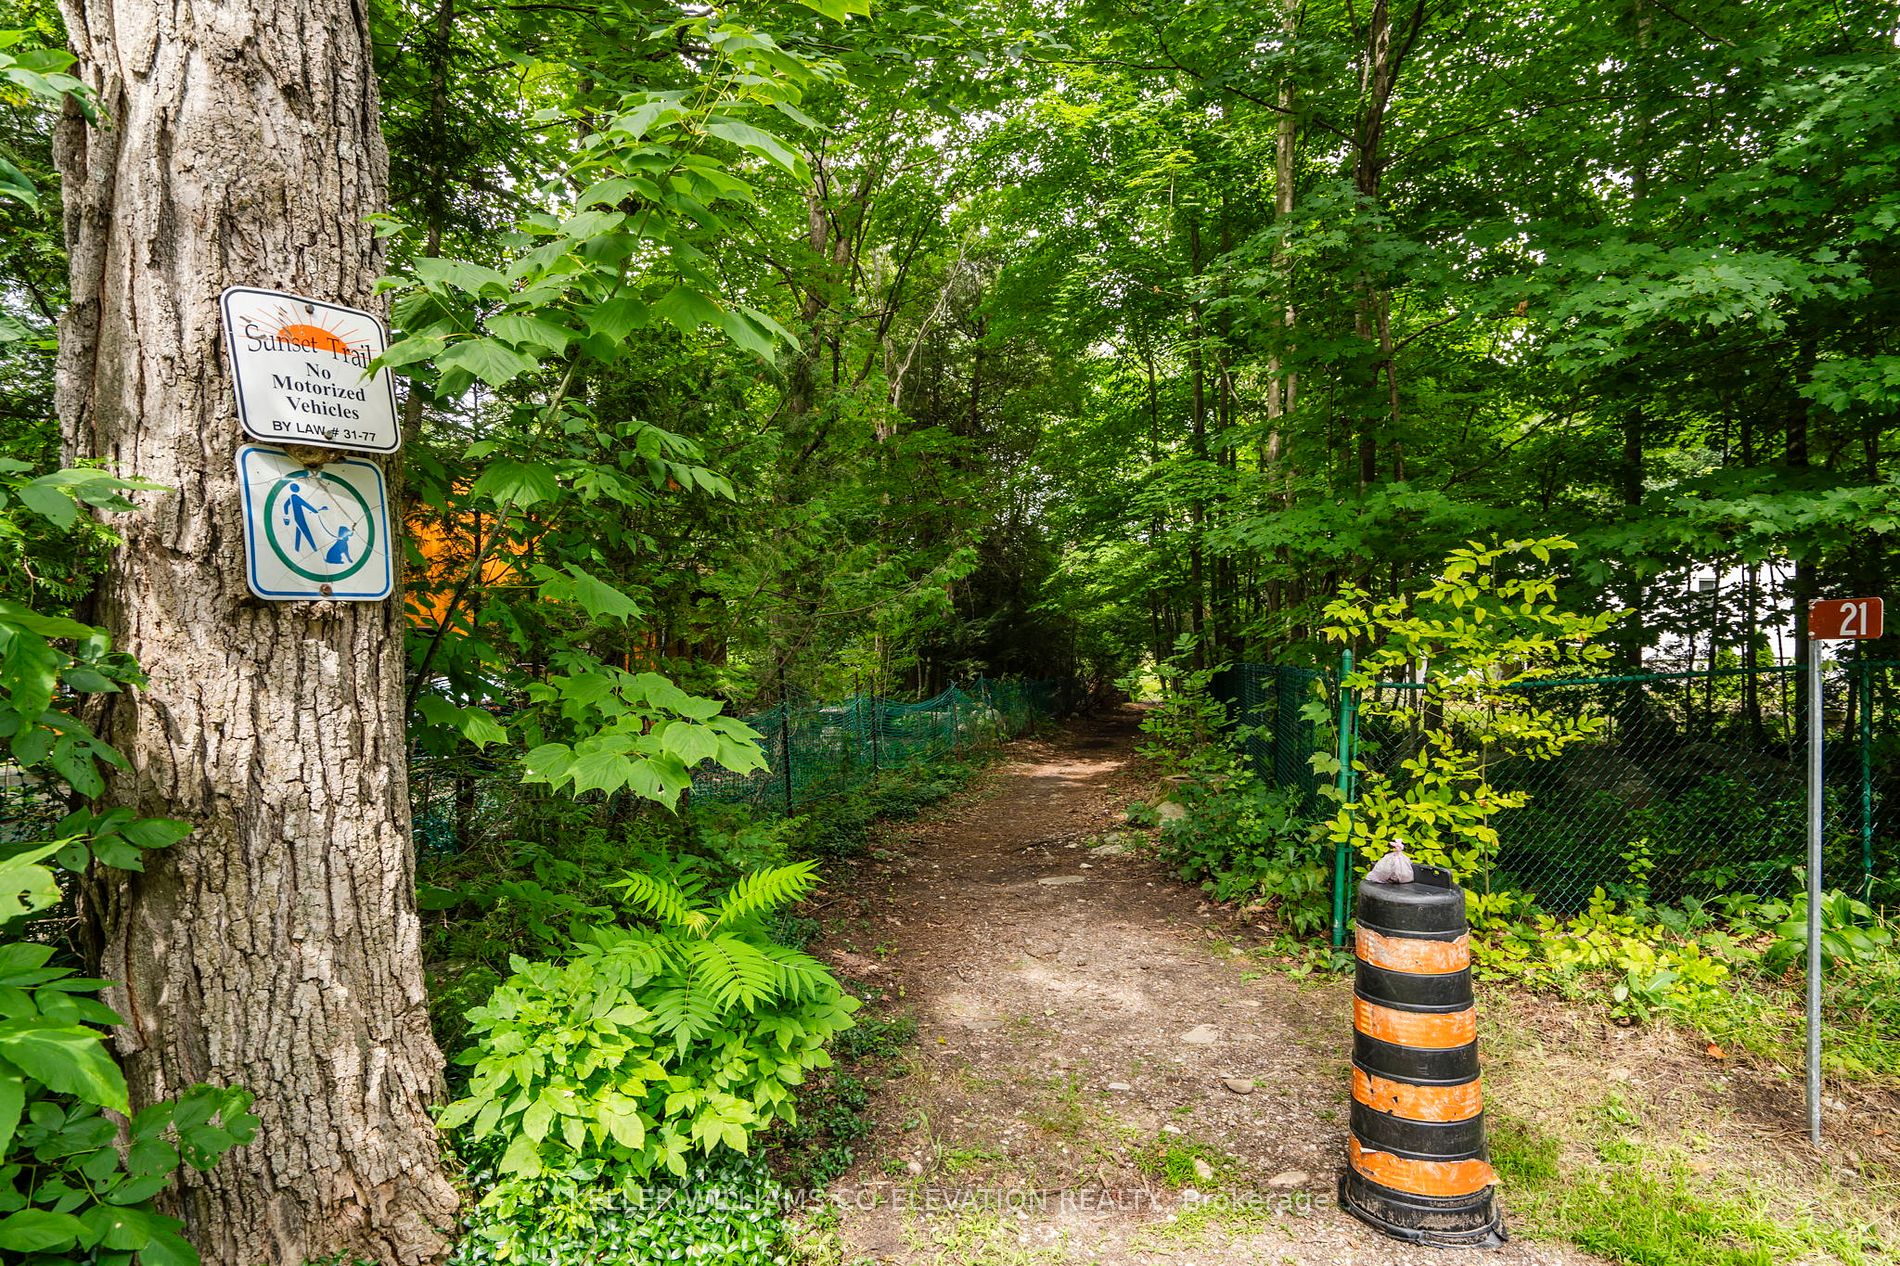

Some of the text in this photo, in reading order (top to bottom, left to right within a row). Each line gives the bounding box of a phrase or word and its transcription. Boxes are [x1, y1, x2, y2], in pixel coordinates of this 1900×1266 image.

[245, 323, 373, 369] Sunset Trail
[305, 362, 331, 380] No
[272, 374, 366, 402] Motorized
[286, 396, 360, 420] Vehicles
[272, 420, 376, 442] BY LAW # 31-77
[1839, 602, 1867, 636] 21
